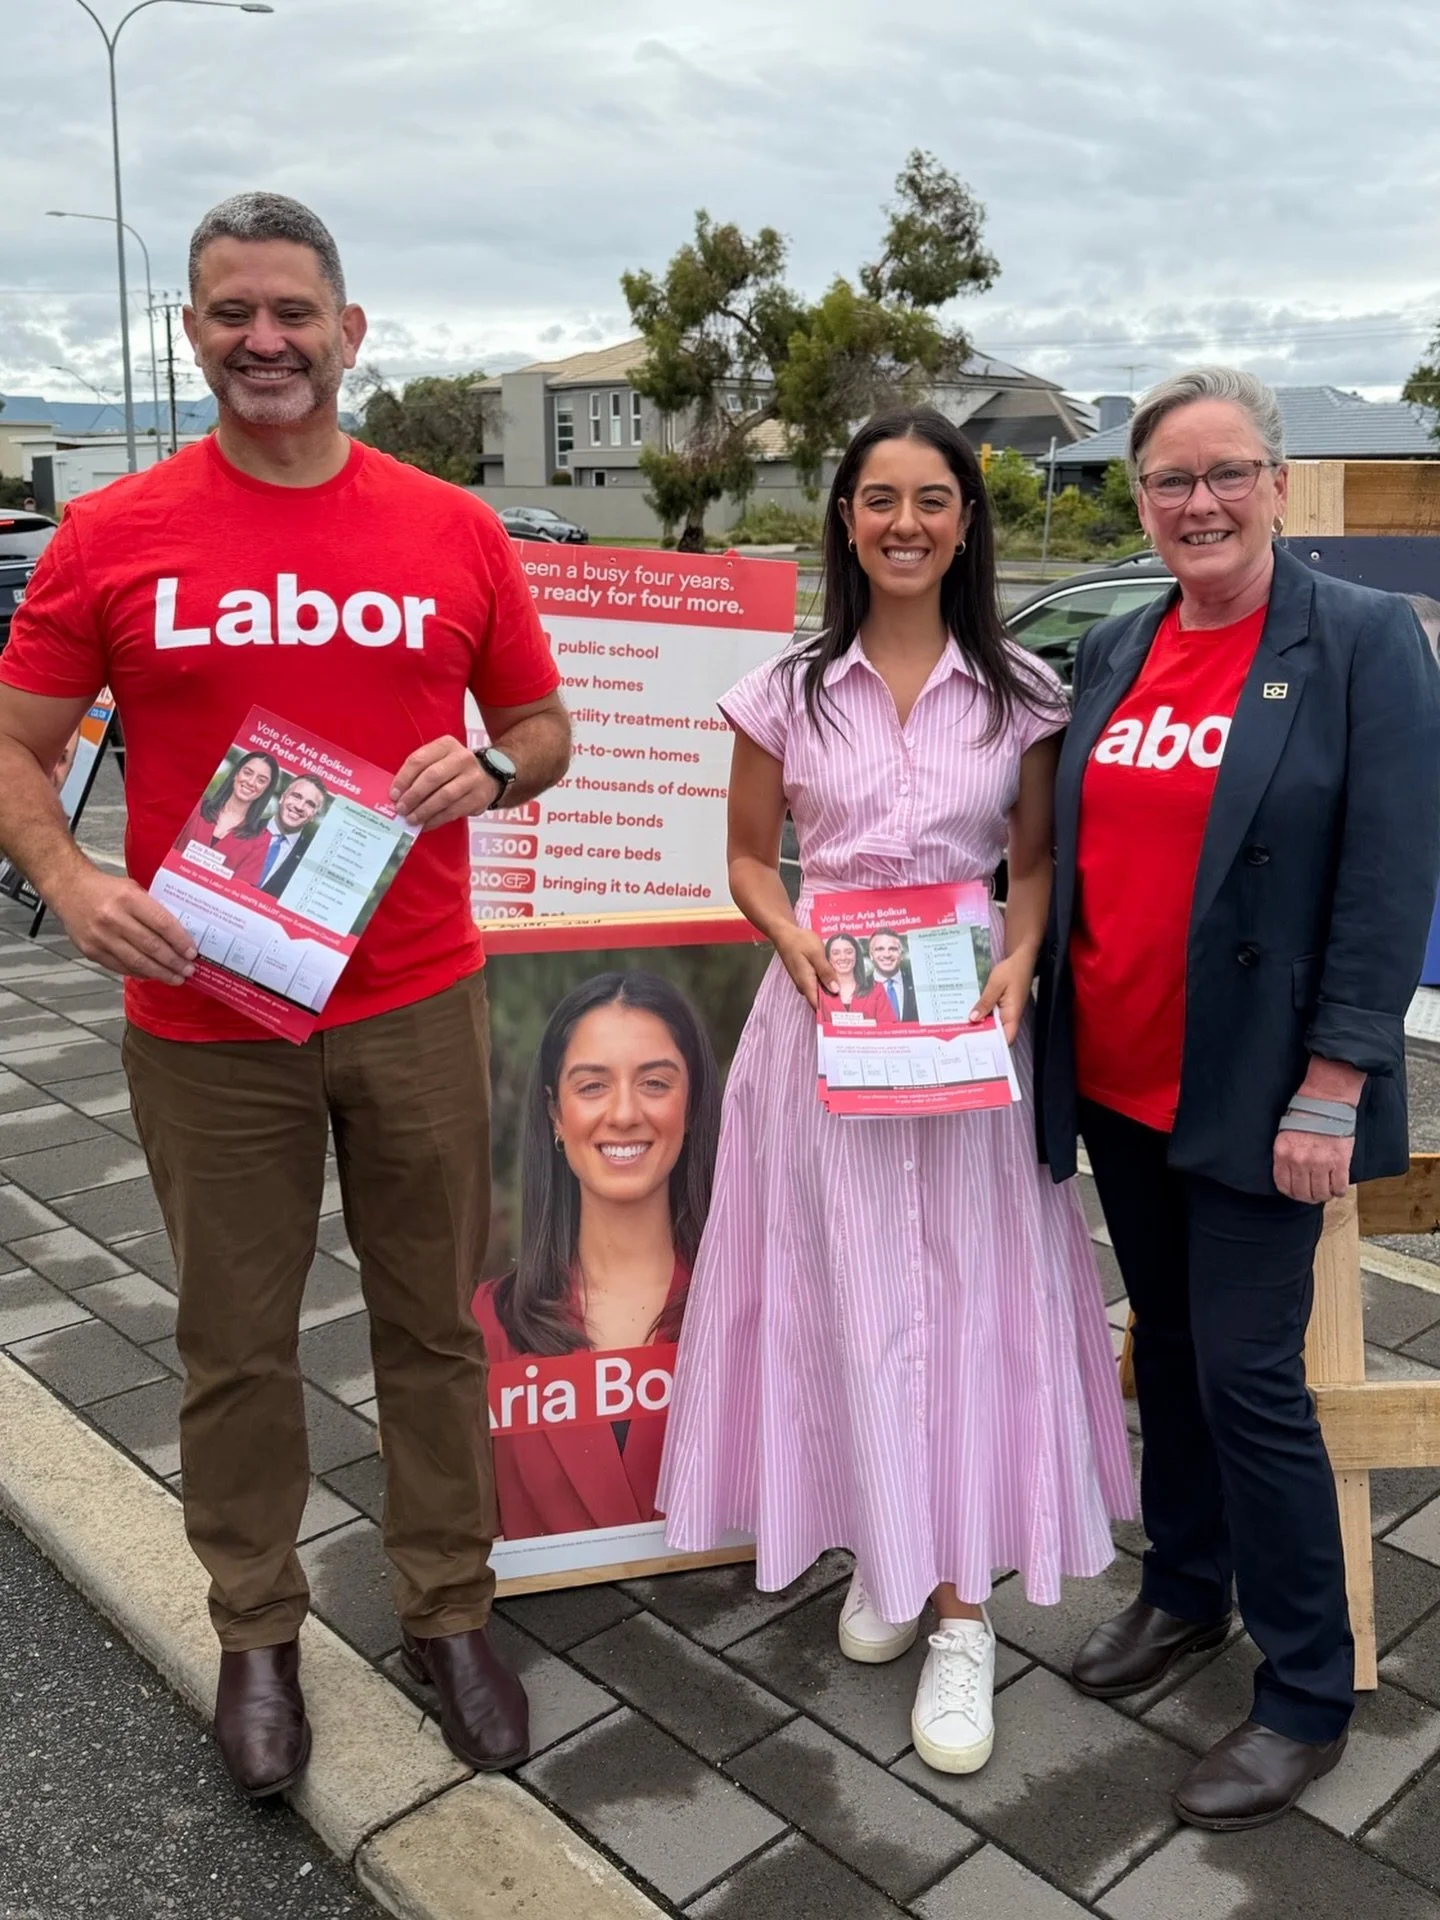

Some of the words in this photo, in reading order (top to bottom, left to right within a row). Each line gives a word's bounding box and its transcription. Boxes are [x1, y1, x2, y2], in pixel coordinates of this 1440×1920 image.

[520, 562, 560, 577] een
[566, 565, 577, 578] a
[584, 562, 629, 586] busy
[635, 566, 674, 586] four
[679, 574, 734, 592] years.
[155, 573, 436, 649] Labor
[544, 584, 602, 606] ready
[607, 586, 635, 606] for
[640, 589, 682, 609] four
[687, 597, 744, 615] more.
[558, 640, 605, 656] public
[609, 644, 660, 660] school
[592, 675, 644, 692] homes
[570, 708, 610, 726] rtility
[614, 712, 691, 729] treatment
[694, 718, 735, 732] reba
[254, 720, 281, 740] Vote
[280, 733, 297, 748] for
[295, 741, 320, 760] Aria
[318, 752, 355, 777] Bolkus
[1088, 706, 1232, 770] abo
[248, 732, 271, 749] and
[269, 742, 300, 764] Peter
[298, 756, 363, 796] Malinauskas
[650, 747, 700, 763] homes
[556, 778, 572, 788] or
[576, 776, 654, 794] thousands
[658, 782, 674, 794] of
[677, 783, 728, 798] downs
[373, 801, 395, 817] Labor
[546, 810, 612, 826] portable
[616, 812, 664, 828] bonds
[478, 838, 532, 856] 1,300
[544, 844, 584, 859] aged
[587, 848, 620, 859] care
[624, 846, 662, 861] beds
[470, 870, 530, 888] otoGP
[542, 876, 606, 895] bringing
[610, 879, 620, 892] it
[625, 882, 640, 894] to
[644, 882, 712, 898] Adelaide
[820, 914, 840, 923] Vote
[857, 911, 875, 920] Aria
[821, 924, 838, 933] and
[840, 922, 864, 930] Peter
[488, 1365, 576, 1430] ria
